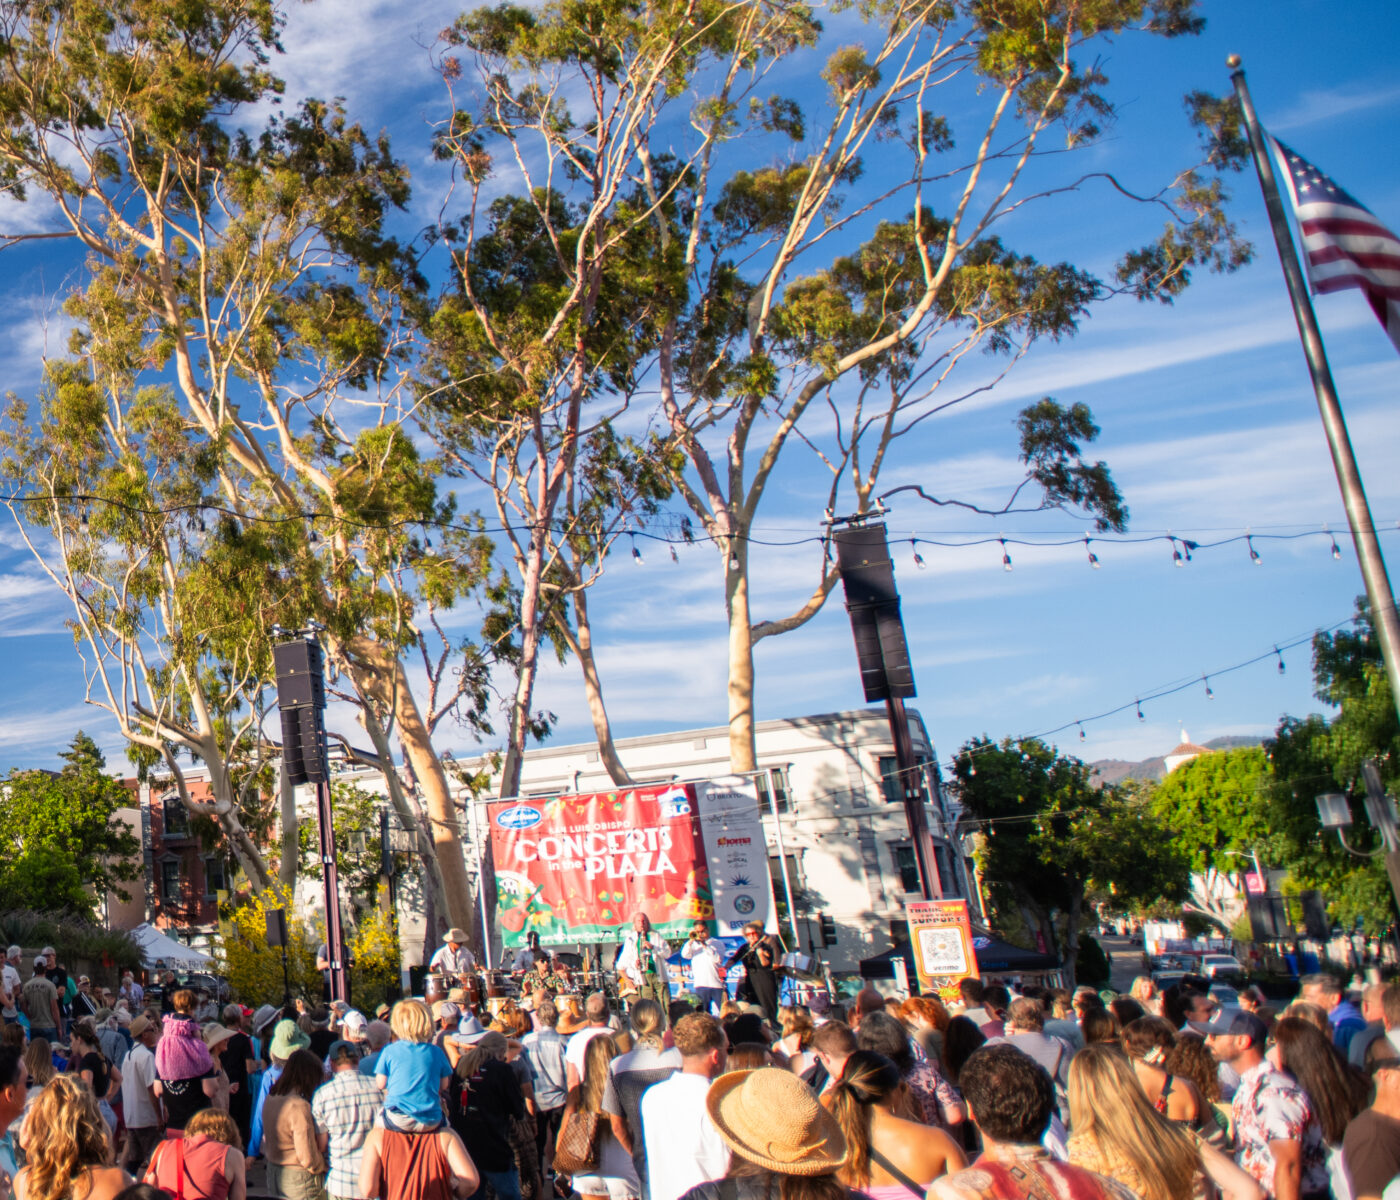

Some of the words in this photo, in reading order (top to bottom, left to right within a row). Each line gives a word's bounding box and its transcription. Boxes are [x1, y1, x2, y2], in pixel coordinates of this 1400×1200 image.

[594, 820, 631, 831] OBISPO
[514, 825, 673, 863] CONCERTS
[548, 860, 560, 871] in
[562, 858, 583, 870] the
[585, 851, 678, 881] PLAZA
